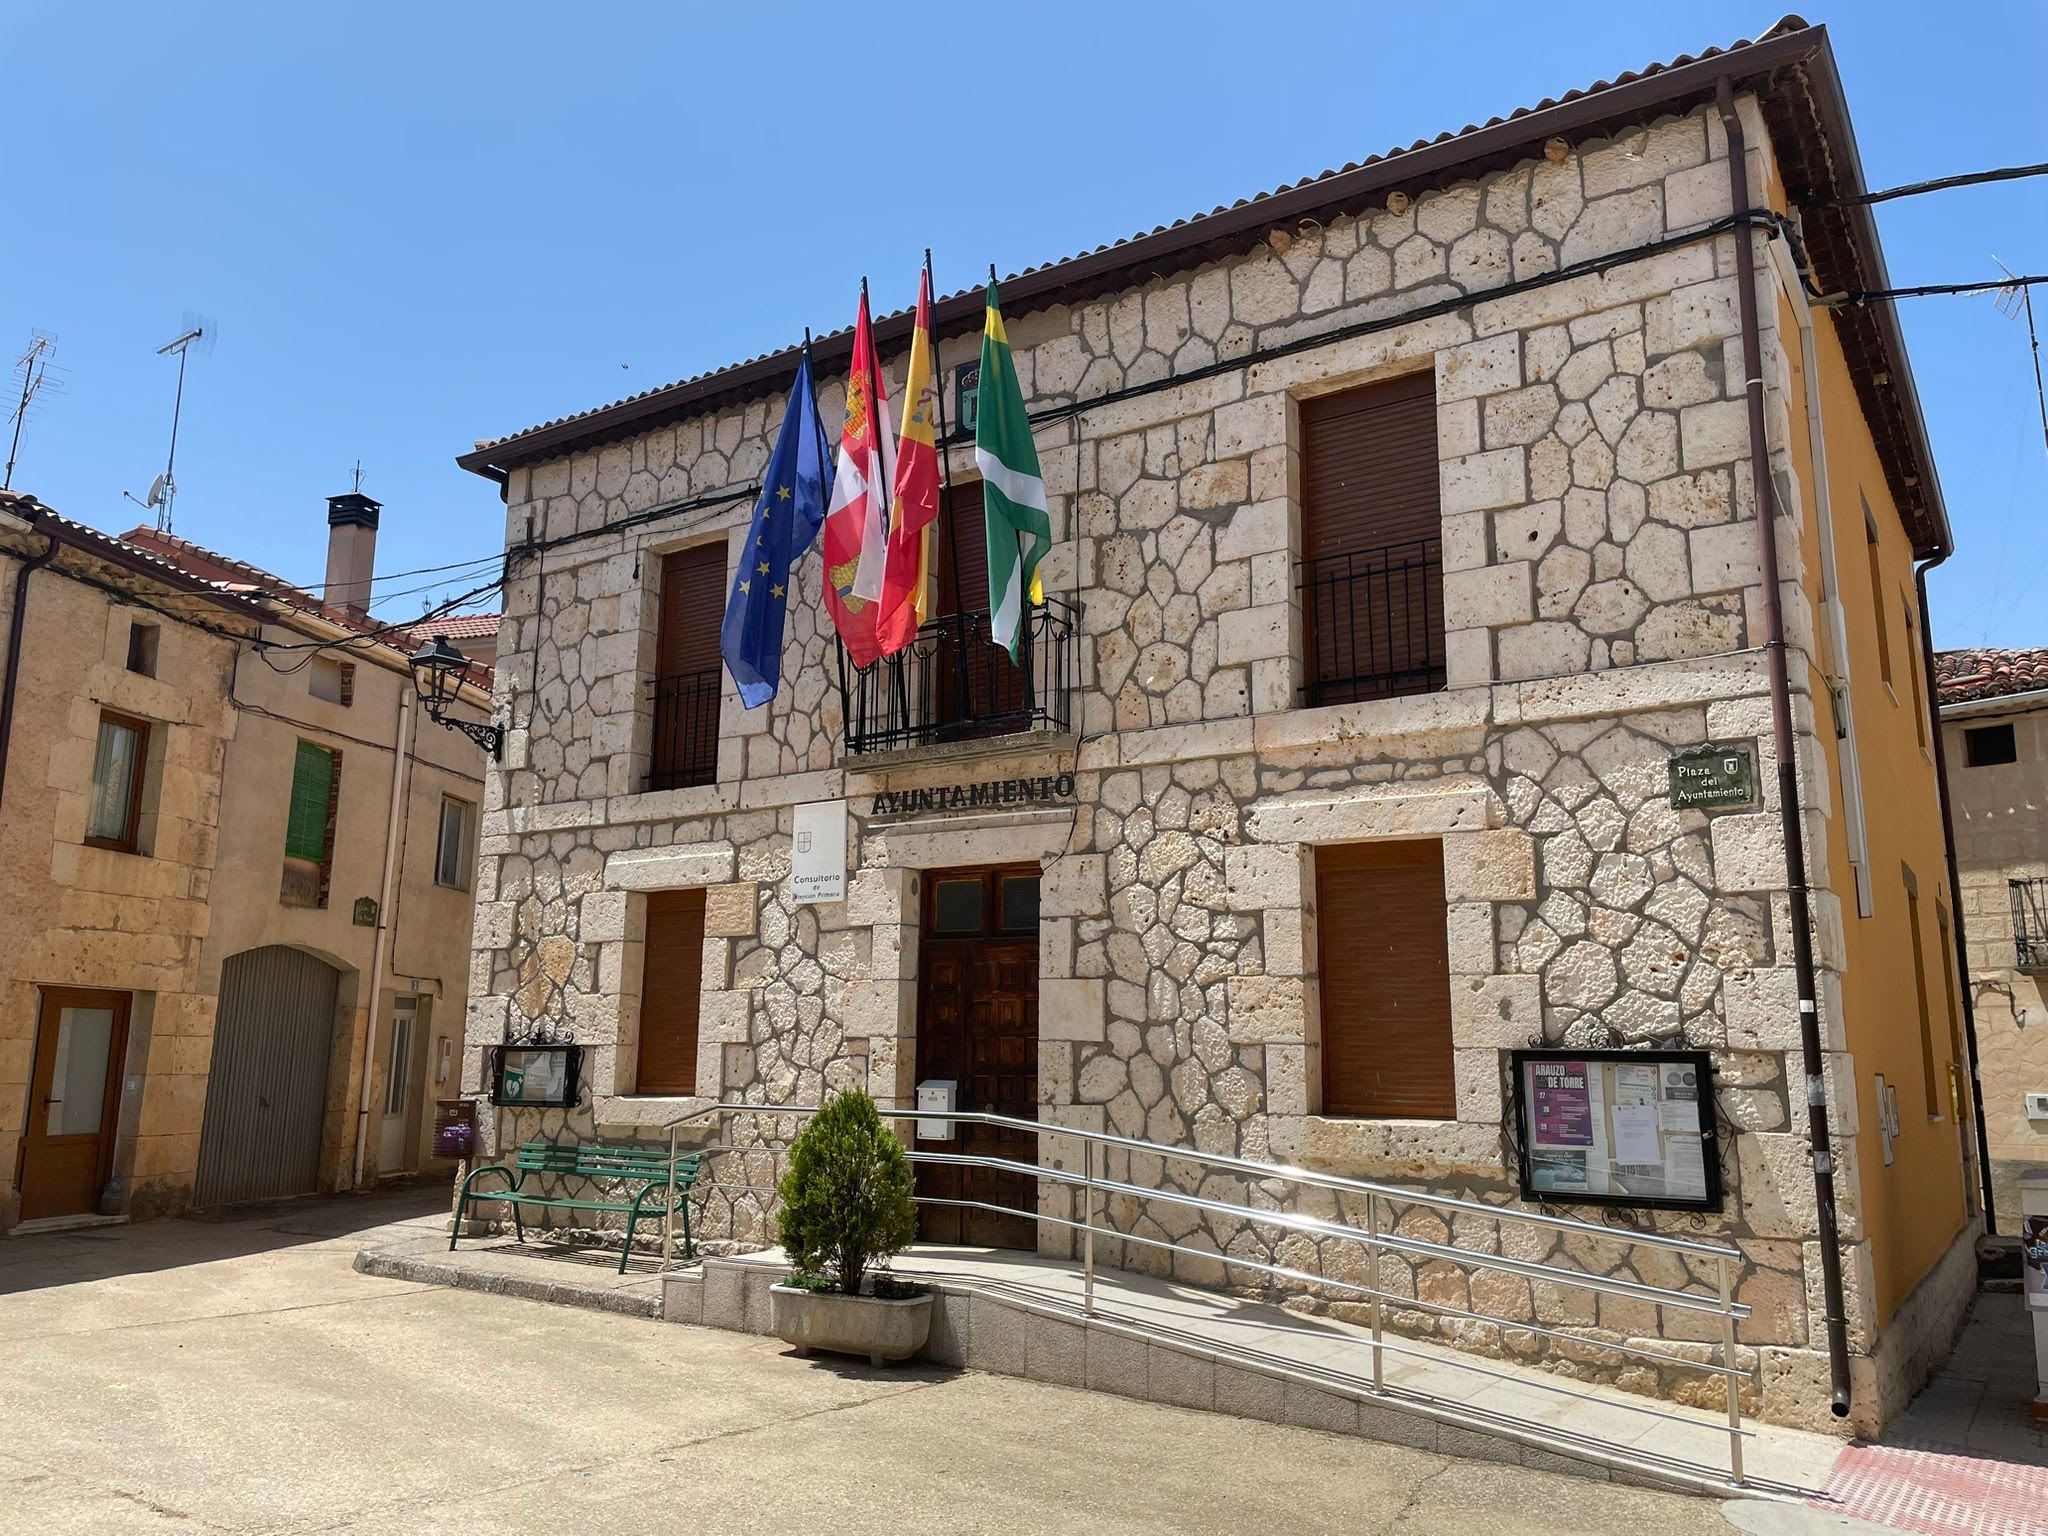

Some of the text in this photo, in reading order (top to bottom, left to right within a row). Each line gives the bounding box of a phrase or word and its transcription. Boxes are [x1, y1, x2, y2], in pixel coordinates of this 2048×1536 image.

[1677, 766, 1711, 777] Plaza
[1701, 777, 1718, 786] del
[871, 774, 1075, 815] AYUNTAMIENTO
[1677, 787, 1744, 803] Ayuntamiento
[794, 874, 840, 884] Consultorio
[1535, 1064, 1565, 1076] ARAUZO
[1548, 1077, 1584, 1089] DE TORRE
[1539, 1091, 1546, 1099] 27
